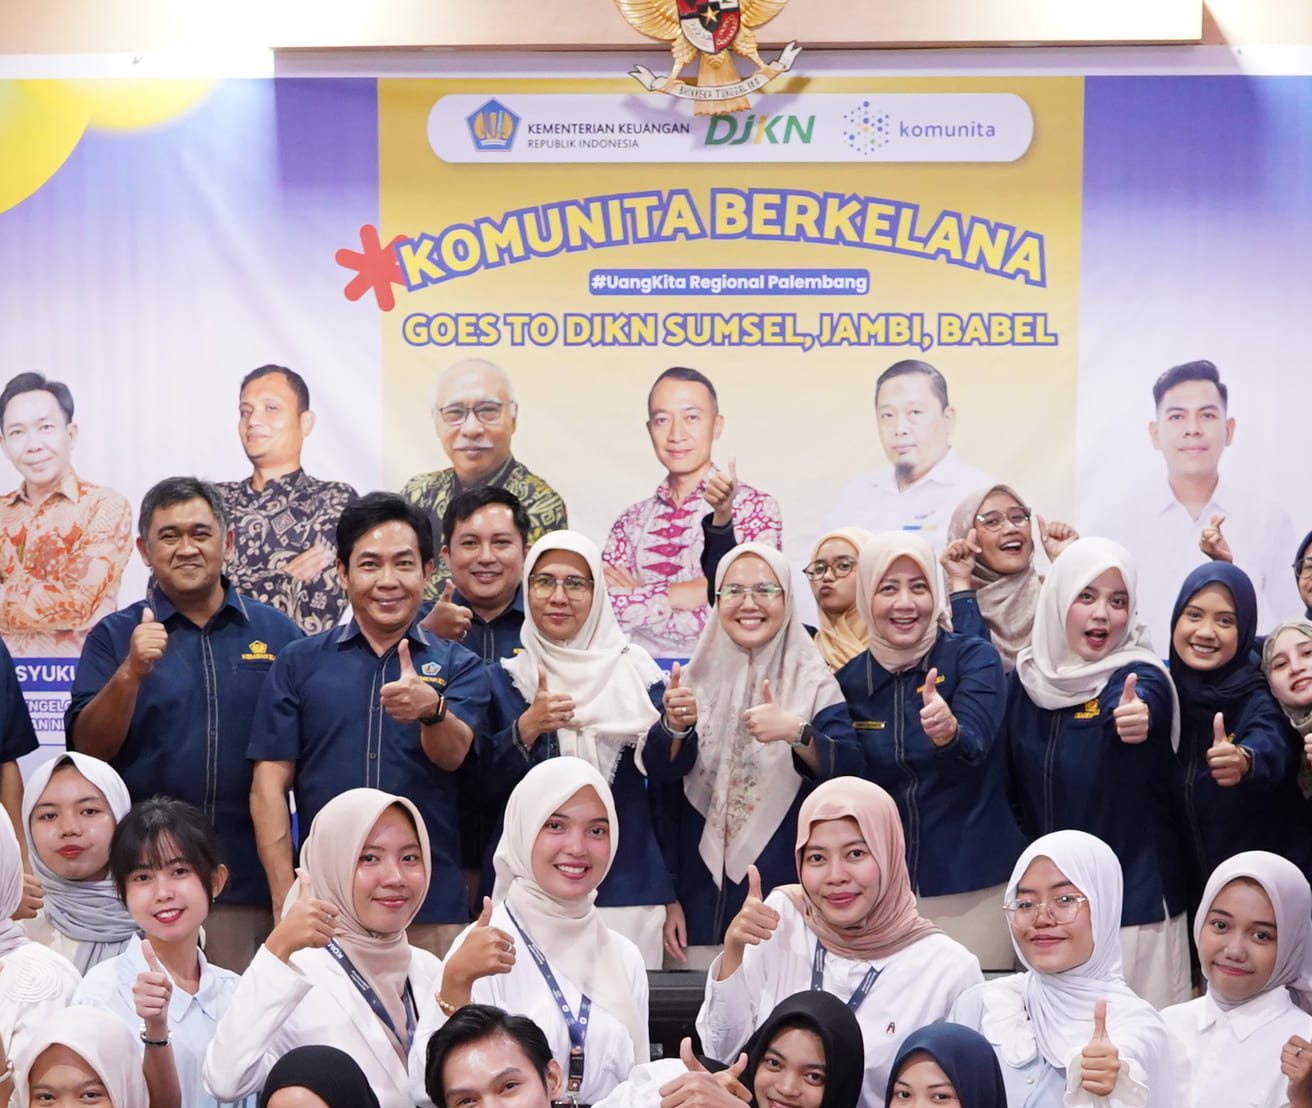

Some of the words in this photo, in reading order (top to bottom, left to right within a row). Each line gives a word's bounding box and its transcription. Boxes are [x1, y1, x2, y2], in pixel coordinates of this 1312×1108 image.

[527, 123, 614, 135] KEMENTERIAN
[618, 122, 690, 134] KEUANGAN
[898, 120, 996, 139] komunita
[527, 138, 578, 149] REPUBLIK
[581, 138, 640, 149] INDONESIA
[395, 190, 706, 292] KOMUNITA
[711, 188, 1046, 288] BERKELANA
[591, 274, 686, 294] #UangKita
[690, 274, 765, 294] Regional
[768, 274, 868, 294] Palembang
[403, 313, 501, 347] GOES
[504, 313, 558, 347] TO
[564, 312, 658, 348] DJKN
[663, 313, 815, 352] SUMSEL,
[817, 313, 933, 352] JAMBI,
[938, 313, 1058, 347] BABEL
